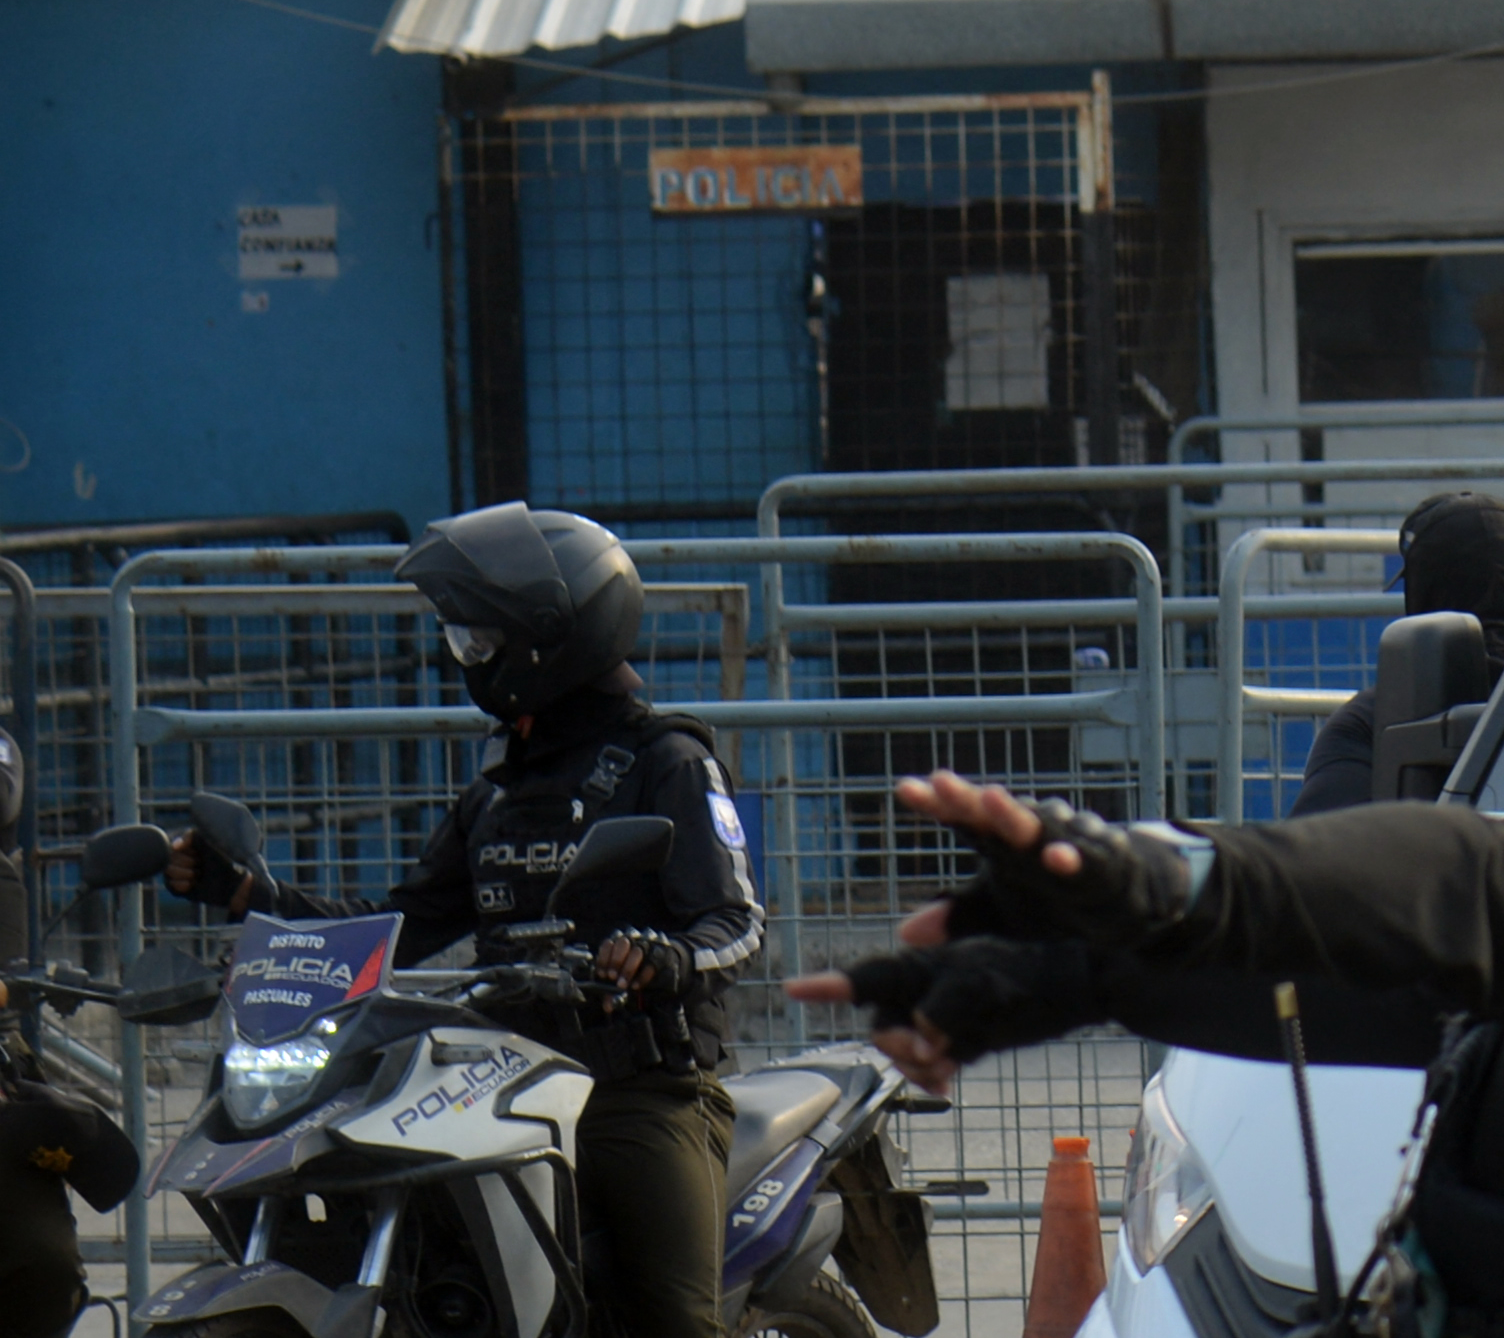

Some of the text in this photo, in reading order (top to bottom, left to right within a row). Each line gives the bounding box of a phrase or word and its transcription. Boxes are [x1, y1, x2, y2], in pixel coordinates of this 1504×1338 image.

[655, 165, 845, 207] POLICIA
[268, 933, 326, 950] DISTRITO
[281, 973, 352, 991] ECUADOR
[243, 988, 313, 1008] PASCUALES
[473, 1058, 532, 1102] ECUADOR
[732, 1178, 785, 1228] 198
